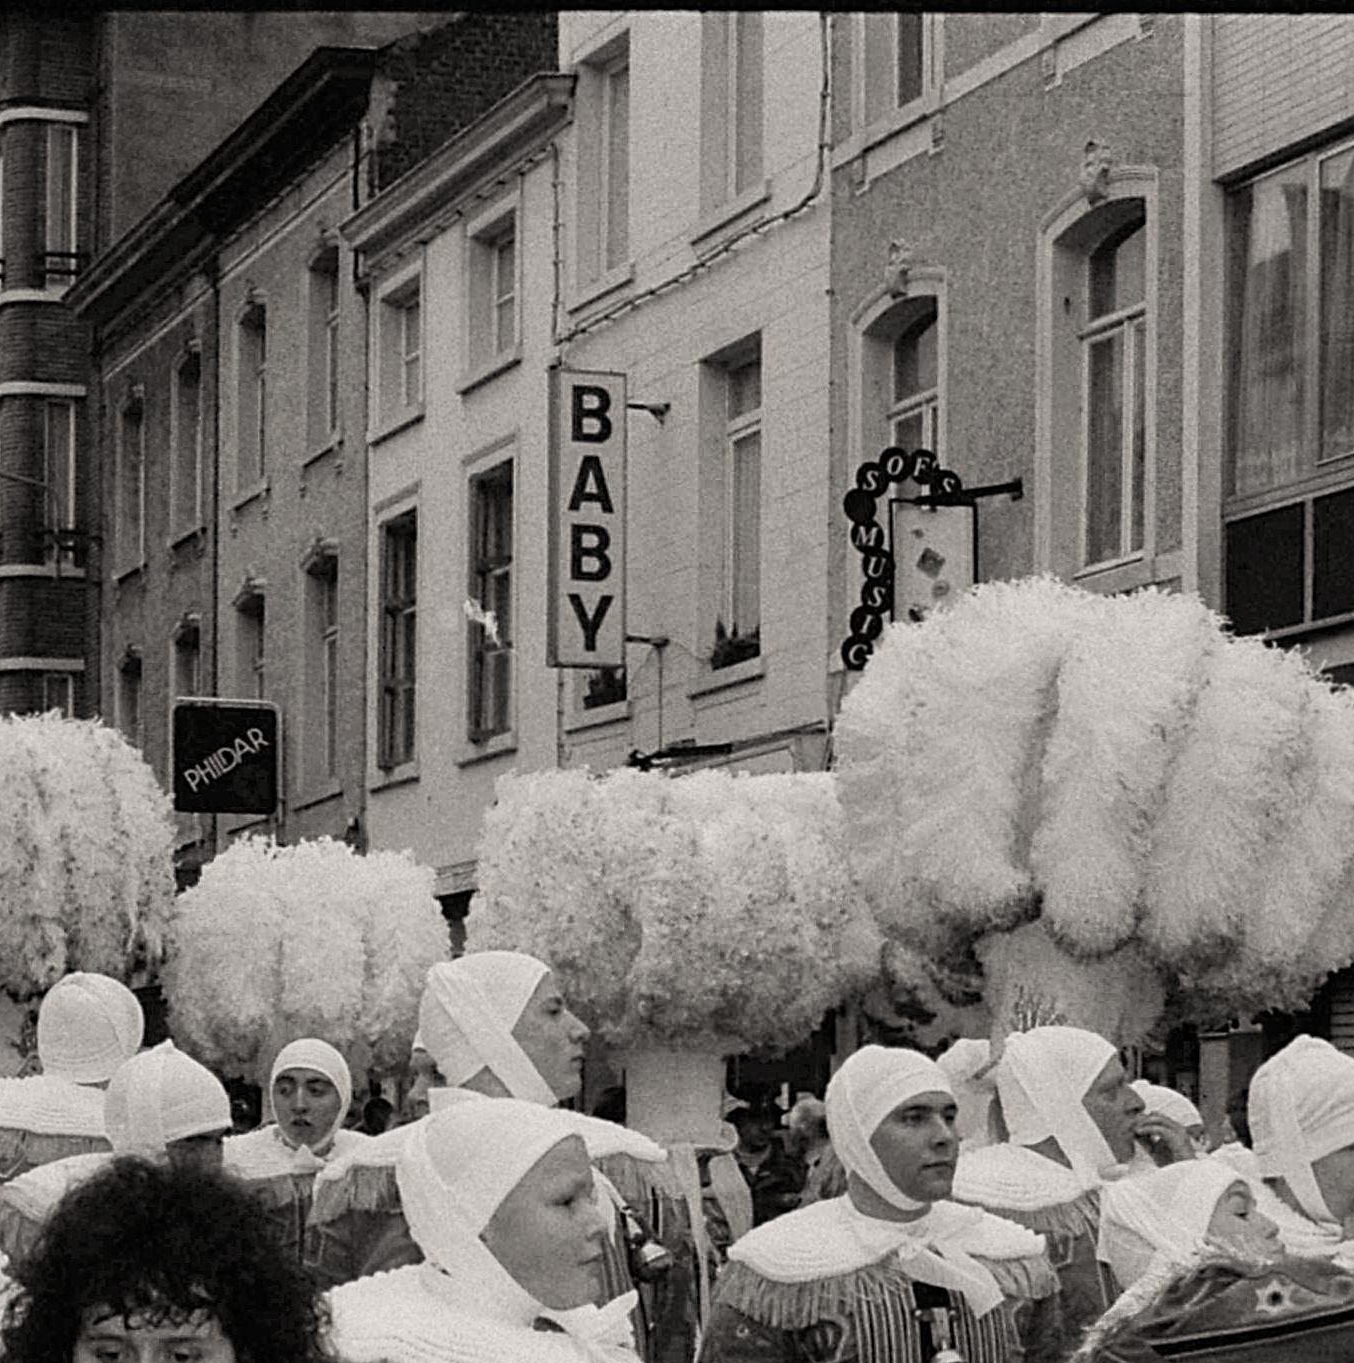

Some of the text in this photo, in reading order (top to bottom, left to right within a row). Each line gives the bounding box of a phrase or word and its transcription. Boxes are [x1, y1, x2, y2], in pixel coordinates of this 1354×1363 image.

[567, 384, 614, 652] BABY
[848, 525, 886, 665] MUSIC
[183, 727, 269, 793] PHIDAR
